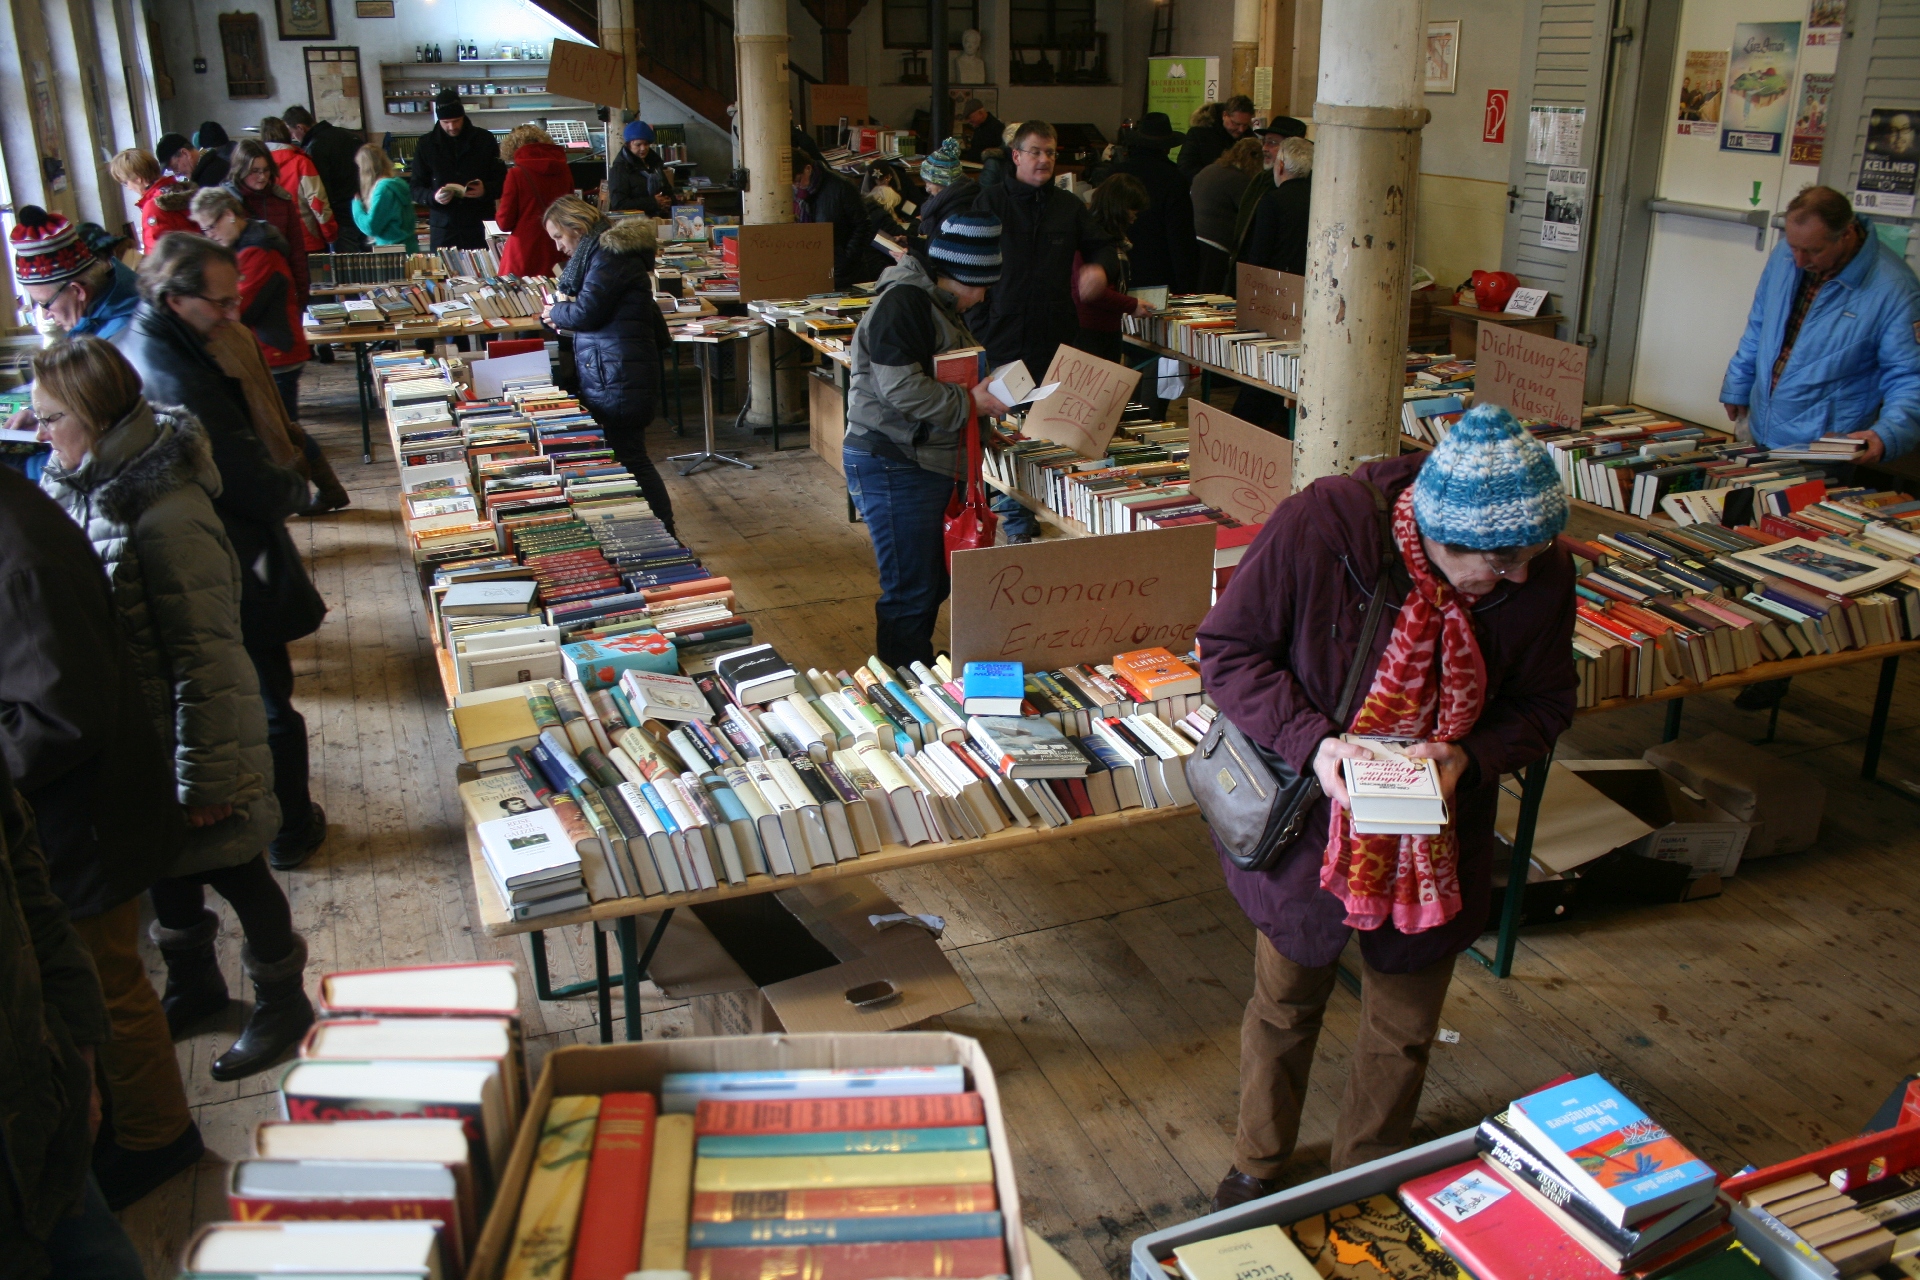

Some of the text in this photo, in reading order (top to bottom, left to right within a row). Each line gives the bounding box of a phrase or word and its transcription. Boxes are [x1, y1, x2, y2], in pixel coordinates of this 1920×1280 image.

[1864, 160, 1917, 174] KELLNER
[750, 233, 821, 254] Religionen
[1244, 273, 1289, 297] Romane
[1481, 329, 1555, 379] Dichtung
[1494, 360, 1558, 402] Drama
[1058, 397, 1098, 426] ECKE
[1512, 388, 1581, 428] Klassiker
[1195, 412, 1279, 489] Romane
[988, 565, 1160, 611] Romane
[1545, 1102, 1604, 1130] Portugiesen
[1601, 1098, 1620, 1111] des
[1573, 1121, 1604, 1136] Haus
[1490, 1146, 1522, 1172] Tribut
[1540, 1185, 1564, 1206] HELEN
[1235, 1264, 1276, 1280] LICHT
